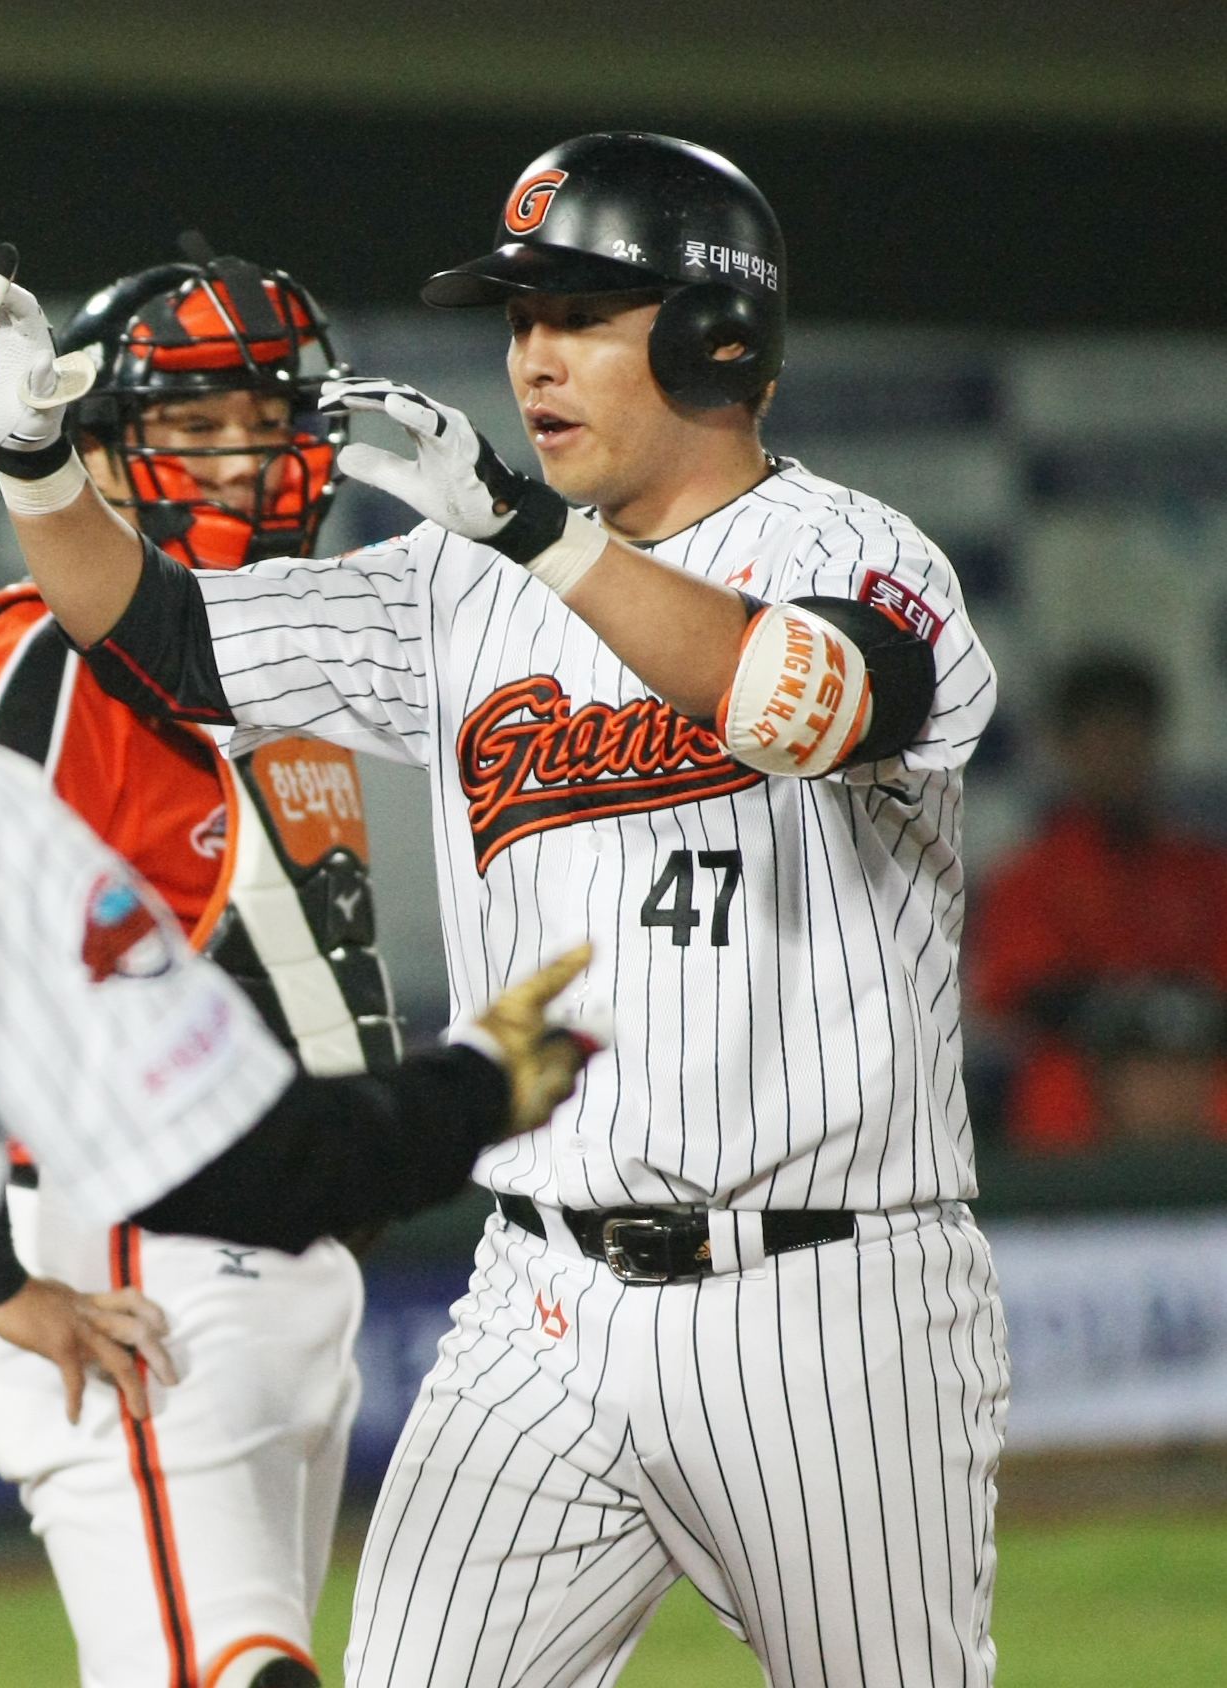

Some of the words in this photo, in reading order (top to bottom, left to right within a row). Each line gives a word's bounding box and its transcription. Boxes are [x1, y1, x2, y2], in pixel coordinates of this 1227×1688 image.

[504, 169, 569, 235] G
[684, 239, 779, 292] 롯데백화점
[871, 578, 935, 640] 롯데
[640, 849, 743, 947] 47
